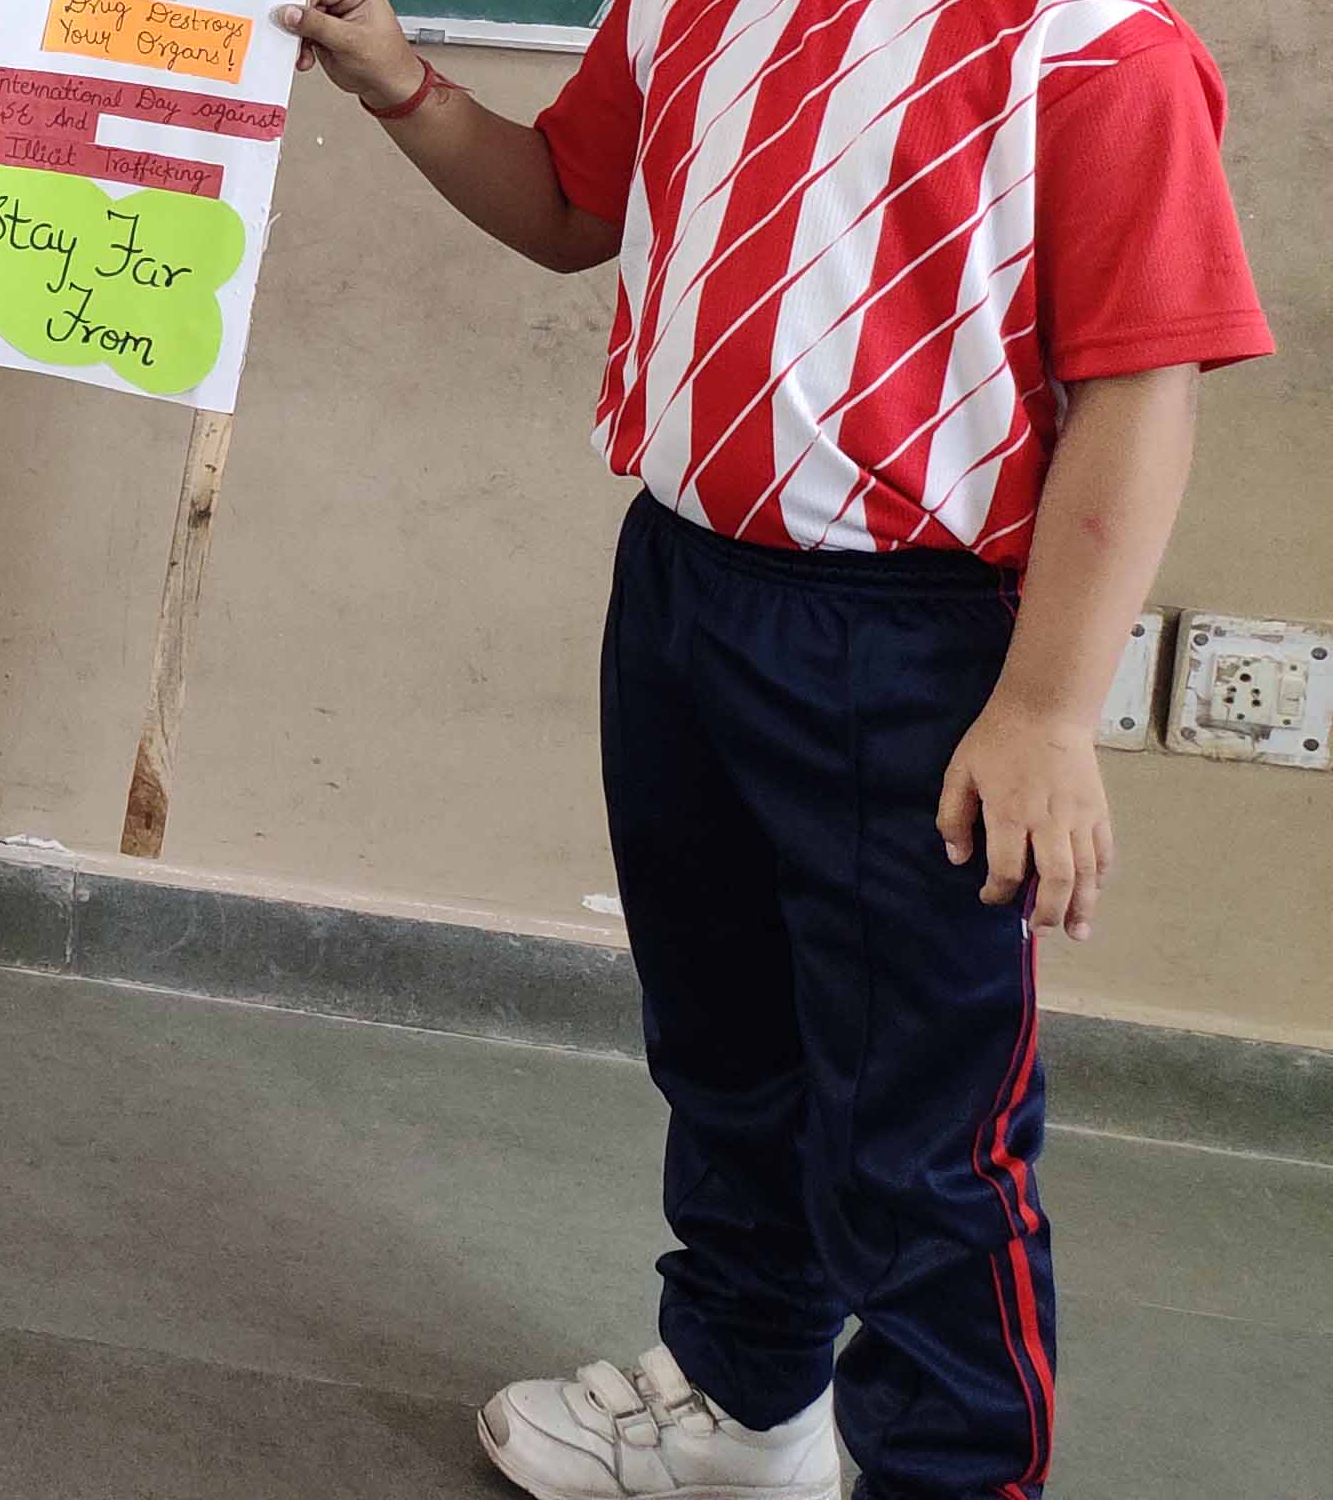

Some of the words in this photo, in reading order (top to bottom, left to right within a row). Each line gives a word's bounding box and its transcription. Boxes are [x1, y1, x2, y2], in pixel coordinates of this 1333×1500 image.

[59, 18, 113, 54] Your
[145, 1, 245, 50] Destroys
[45, 106, 89, 132] And
[134, 86, 182, 124] Day
[96, 145, 212, 193] Trafficking
[94, 209, 193, 288] Far
[46, 282, 155, 368] From
